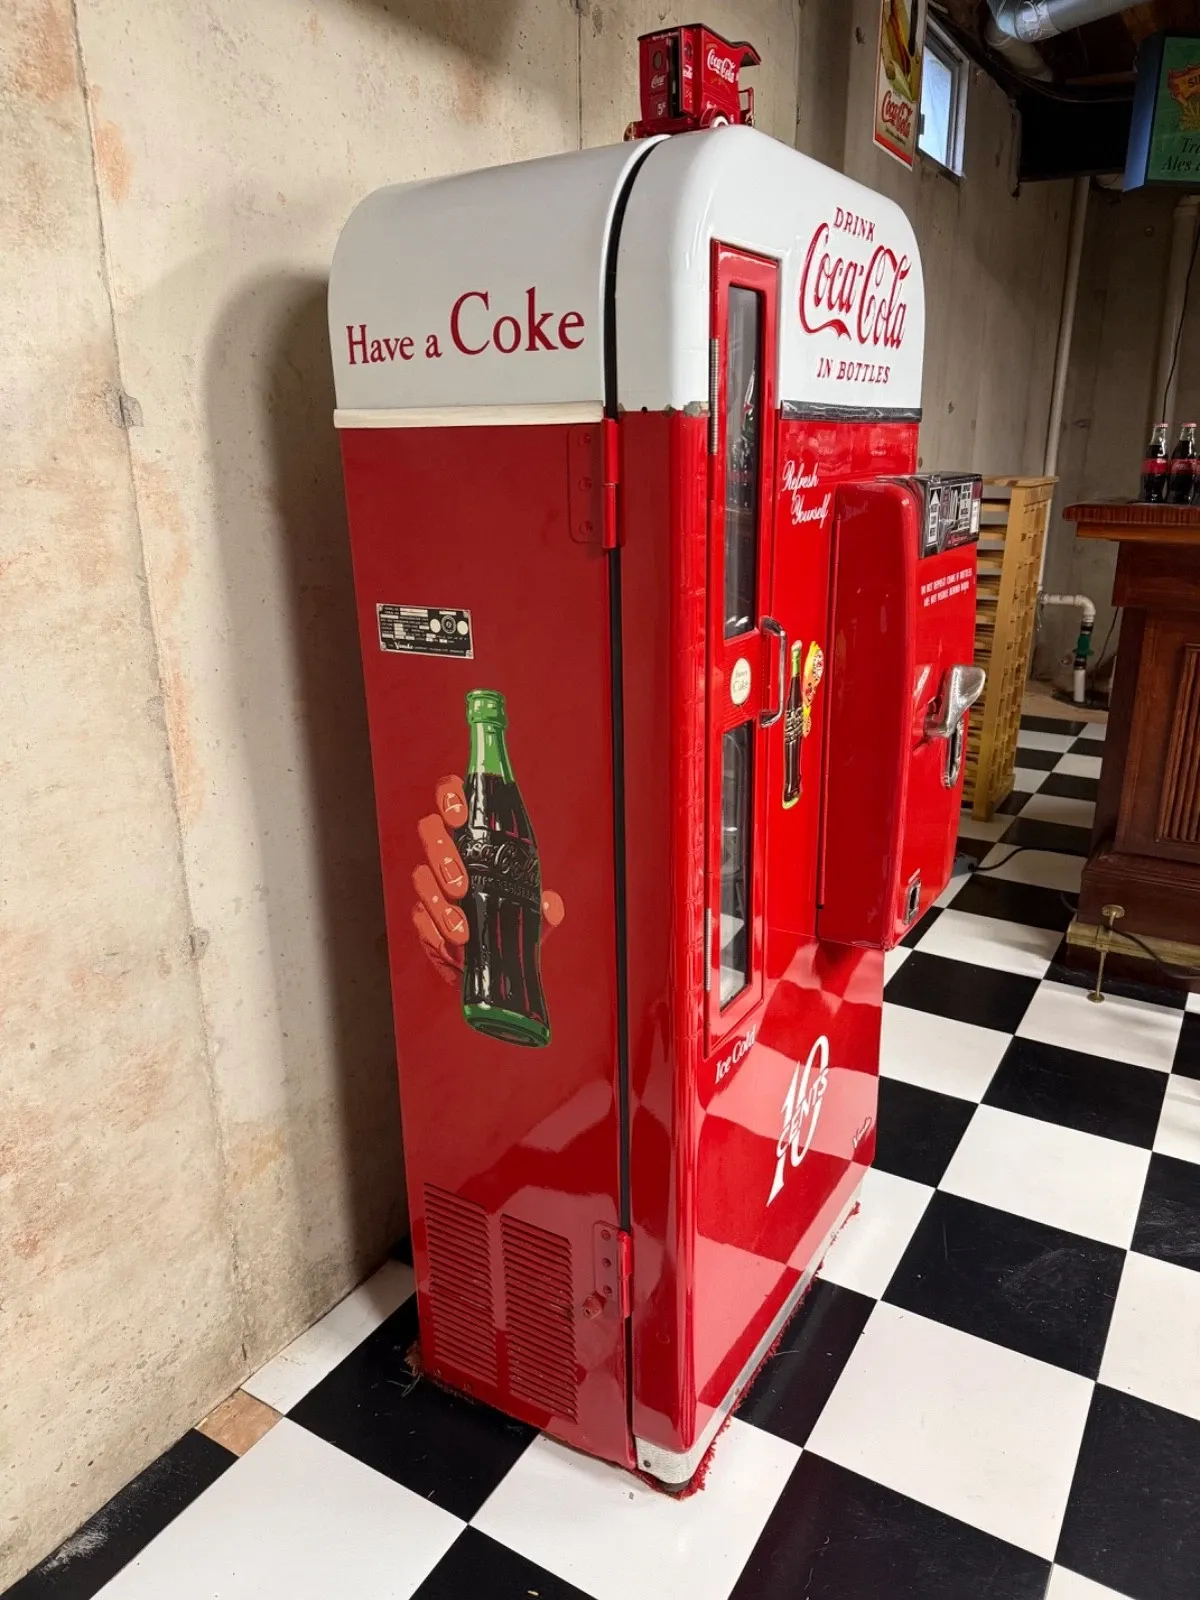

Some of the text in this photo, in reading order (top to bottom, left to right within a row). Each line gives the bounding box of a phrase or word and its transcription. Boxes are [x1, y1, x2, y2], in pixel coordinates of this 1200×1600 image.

[707, 49, 735, 83] Coca-Cola
[882, 90, 913, 139] Coca-Cola
[1161, 155, 1191, 172] Ales
[834, 207, 876, 242] DRINK
[798, 222, 912, 350] Coca-Cola
[346, 286, 585, 365] Have a Coke
[817, 357, 891, 384] IN BOTTLES
[781, 460, 820, 501] Refresh
[790, 492, 832, 529] Yourself
[715, 1024, 757, 1084] Ice Cold
[766, 1034, 830, 1207] 10
[776, 1067, 829, 1158] CENTS
